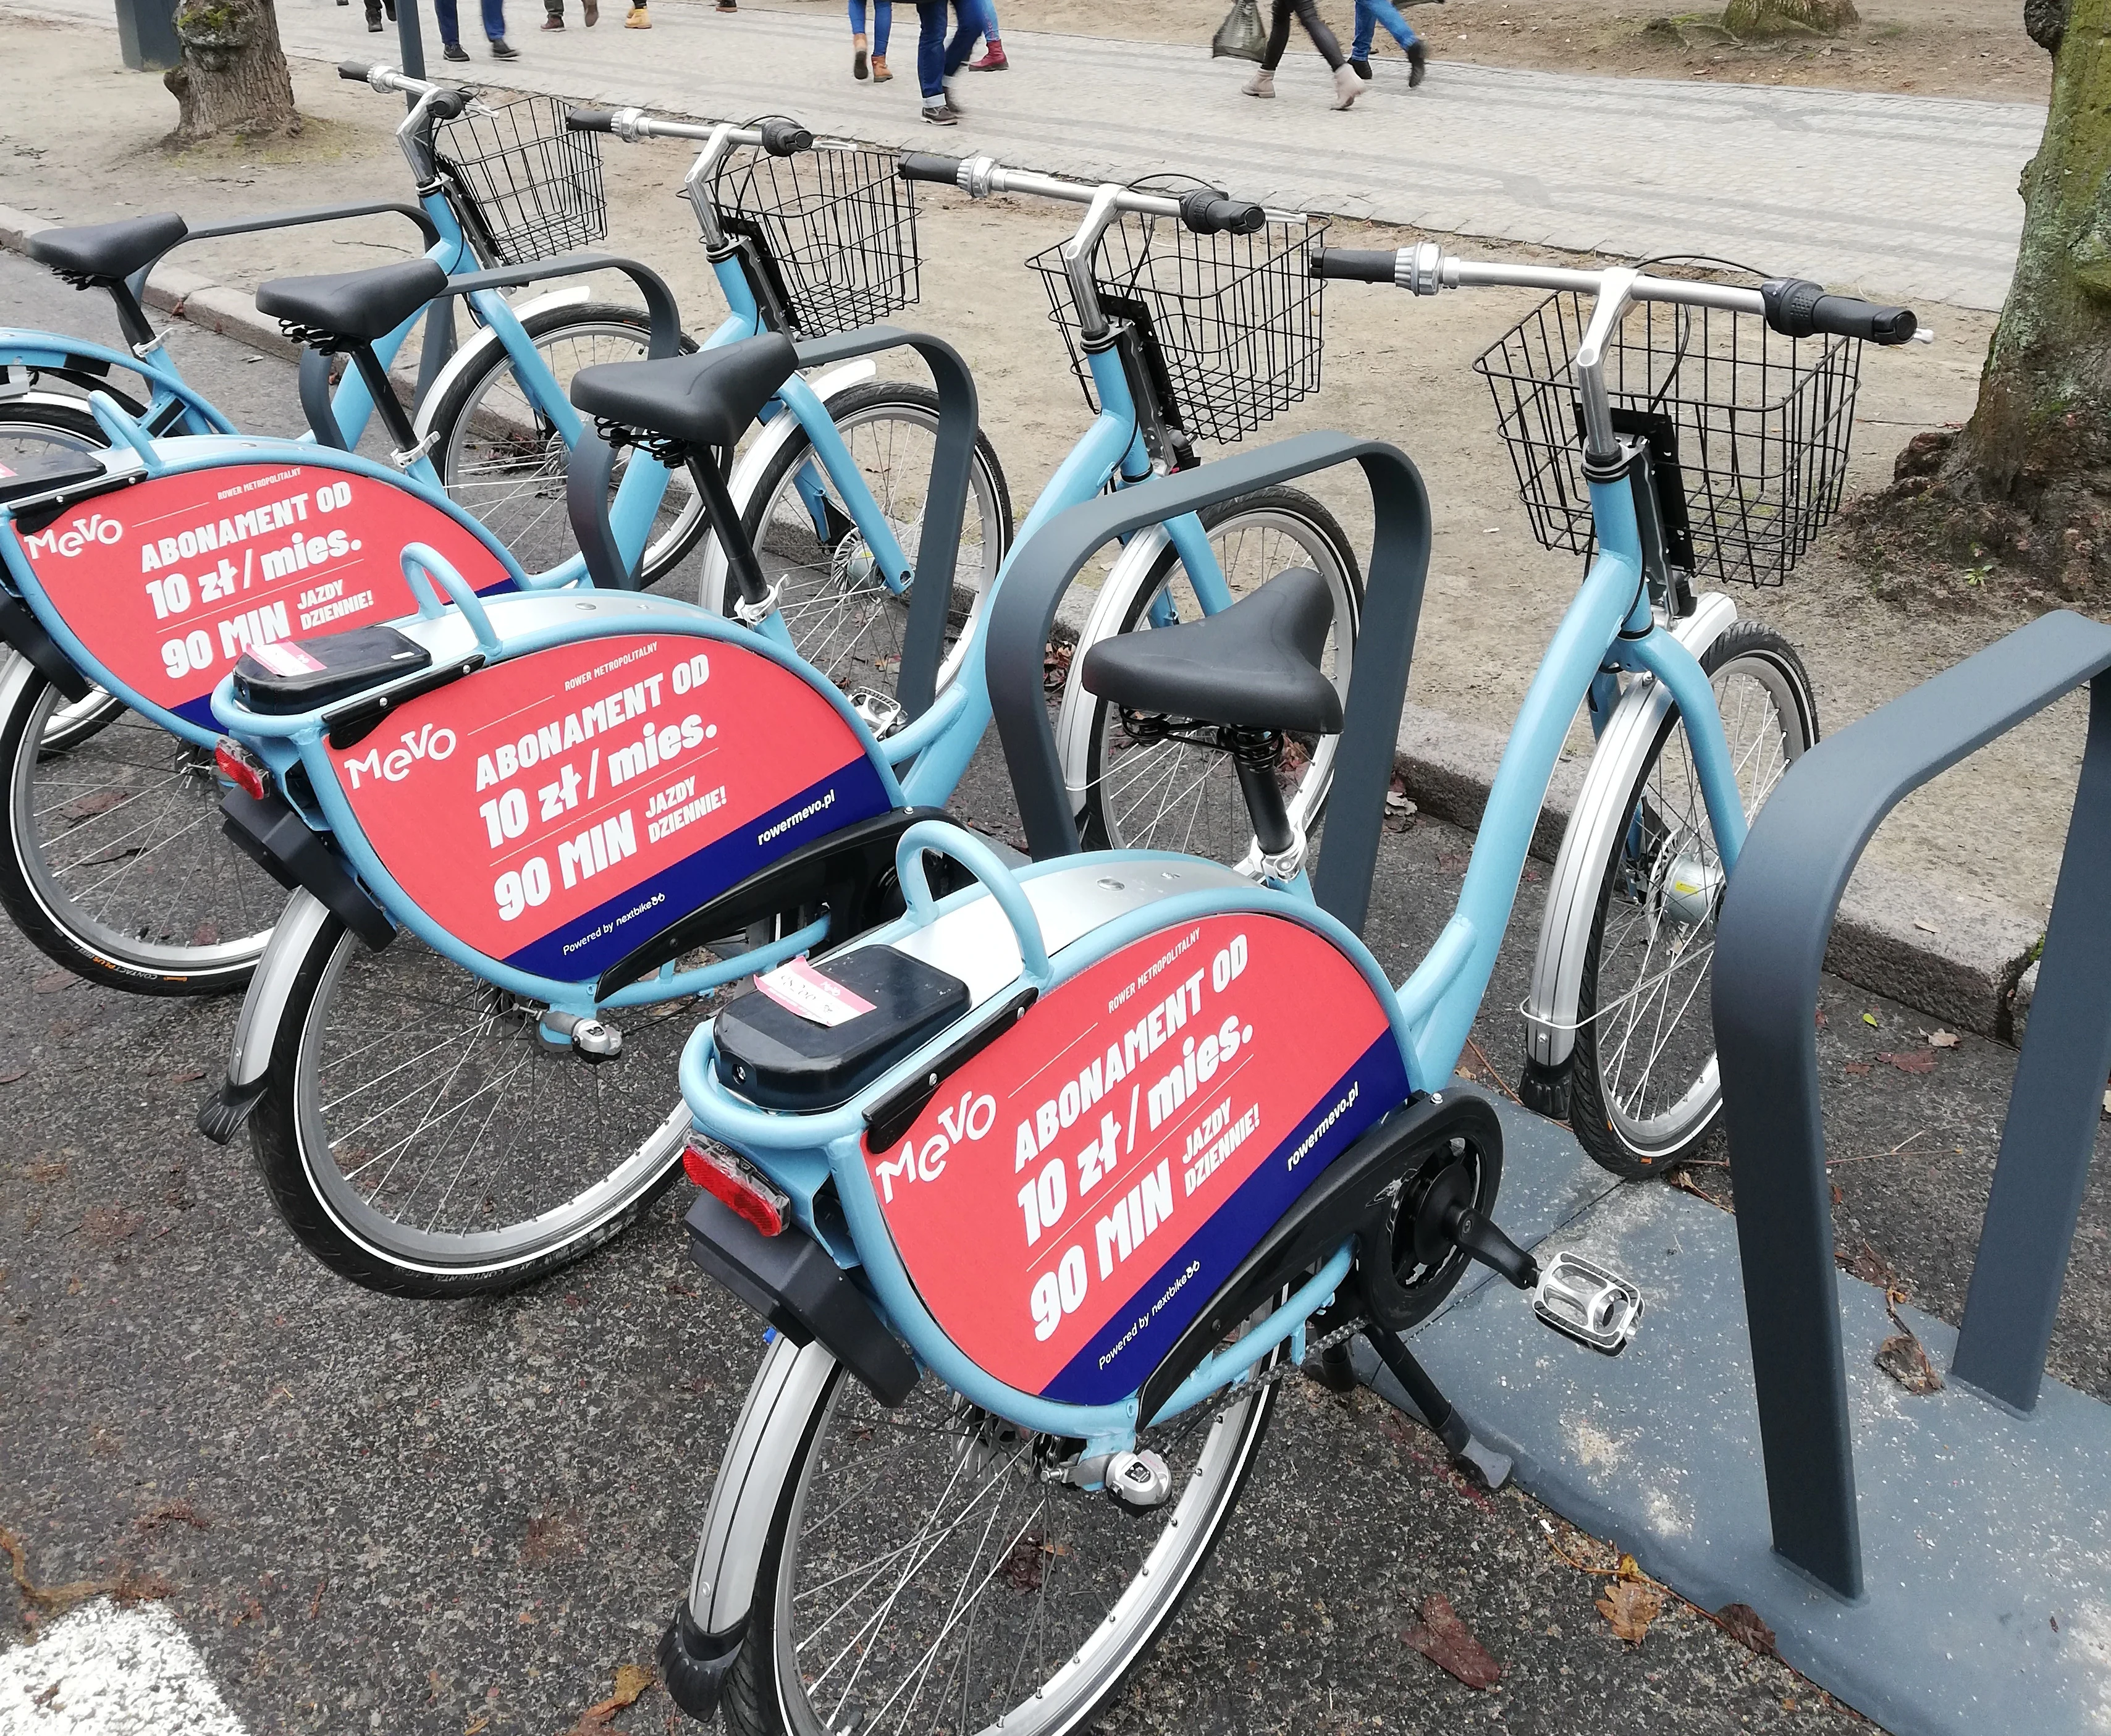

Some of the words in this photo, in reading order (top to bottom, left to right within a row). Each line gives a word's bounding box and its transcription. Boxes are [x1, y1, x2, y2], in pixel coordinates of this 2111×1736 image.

[217, 486, 243, 500] ROWER
[243, 467, 301, 492] METROPOLITALNY
[142, 493, 308, 573] ABONAMENT
[316, 481, 352, 512] OD
[146, 573, 192, 619] 10
[297, 579, 343, 609] JAZDY
[300, 590, 374, 630] DZIENNIE!
[161, 630, 213, 678] 90
[217, 600, 291, 659] MIN
[565, 671, 592, 691] ROWER
[594, 641, 657, 678] METROPOLITALNY
[476, 673, 663, 792] ABONAMENT
[672, 654, 709, 694] OD
[479, 788, 529, 848] 10
[646, 775, 695, 818] JAZDY
[648, 786, 727, 843] DZIENNIE!
[757, 790, 835, 846] rowermevo.pl
[494, 857, 551, 921] 90
[558, 809, 637, 890] MIN
[563, 927, 602, 956] Powered
[603, 922, 613, 933] by
[616, 901, 652, 927] nextbike
[1108, 982, 1136, 1014] ROWER
[1137, 927, 1200, 989] METROPOLITALNY
[1016, 967, 1205, 1173] ABONAMENT
[1213, 934, 1247, 992] OD
[1182, 1097, 1231, 1163] JAZDY
[1184, 1103, 1260, 1197] DZIENNIE!
[1288, 1081, 1359, 1171] rowermevo.pl
[1018, 1158, 1067, 1247] 10
[1030, 1245, 1087, 1341] 90
[1095, 1158, 1173, 1281] MIN
[1098, 1322, 1138, 1370] Powered
[1139, 1312, 1149, 1329] by
[1152, 1279, 1187, 1317] nextbike
